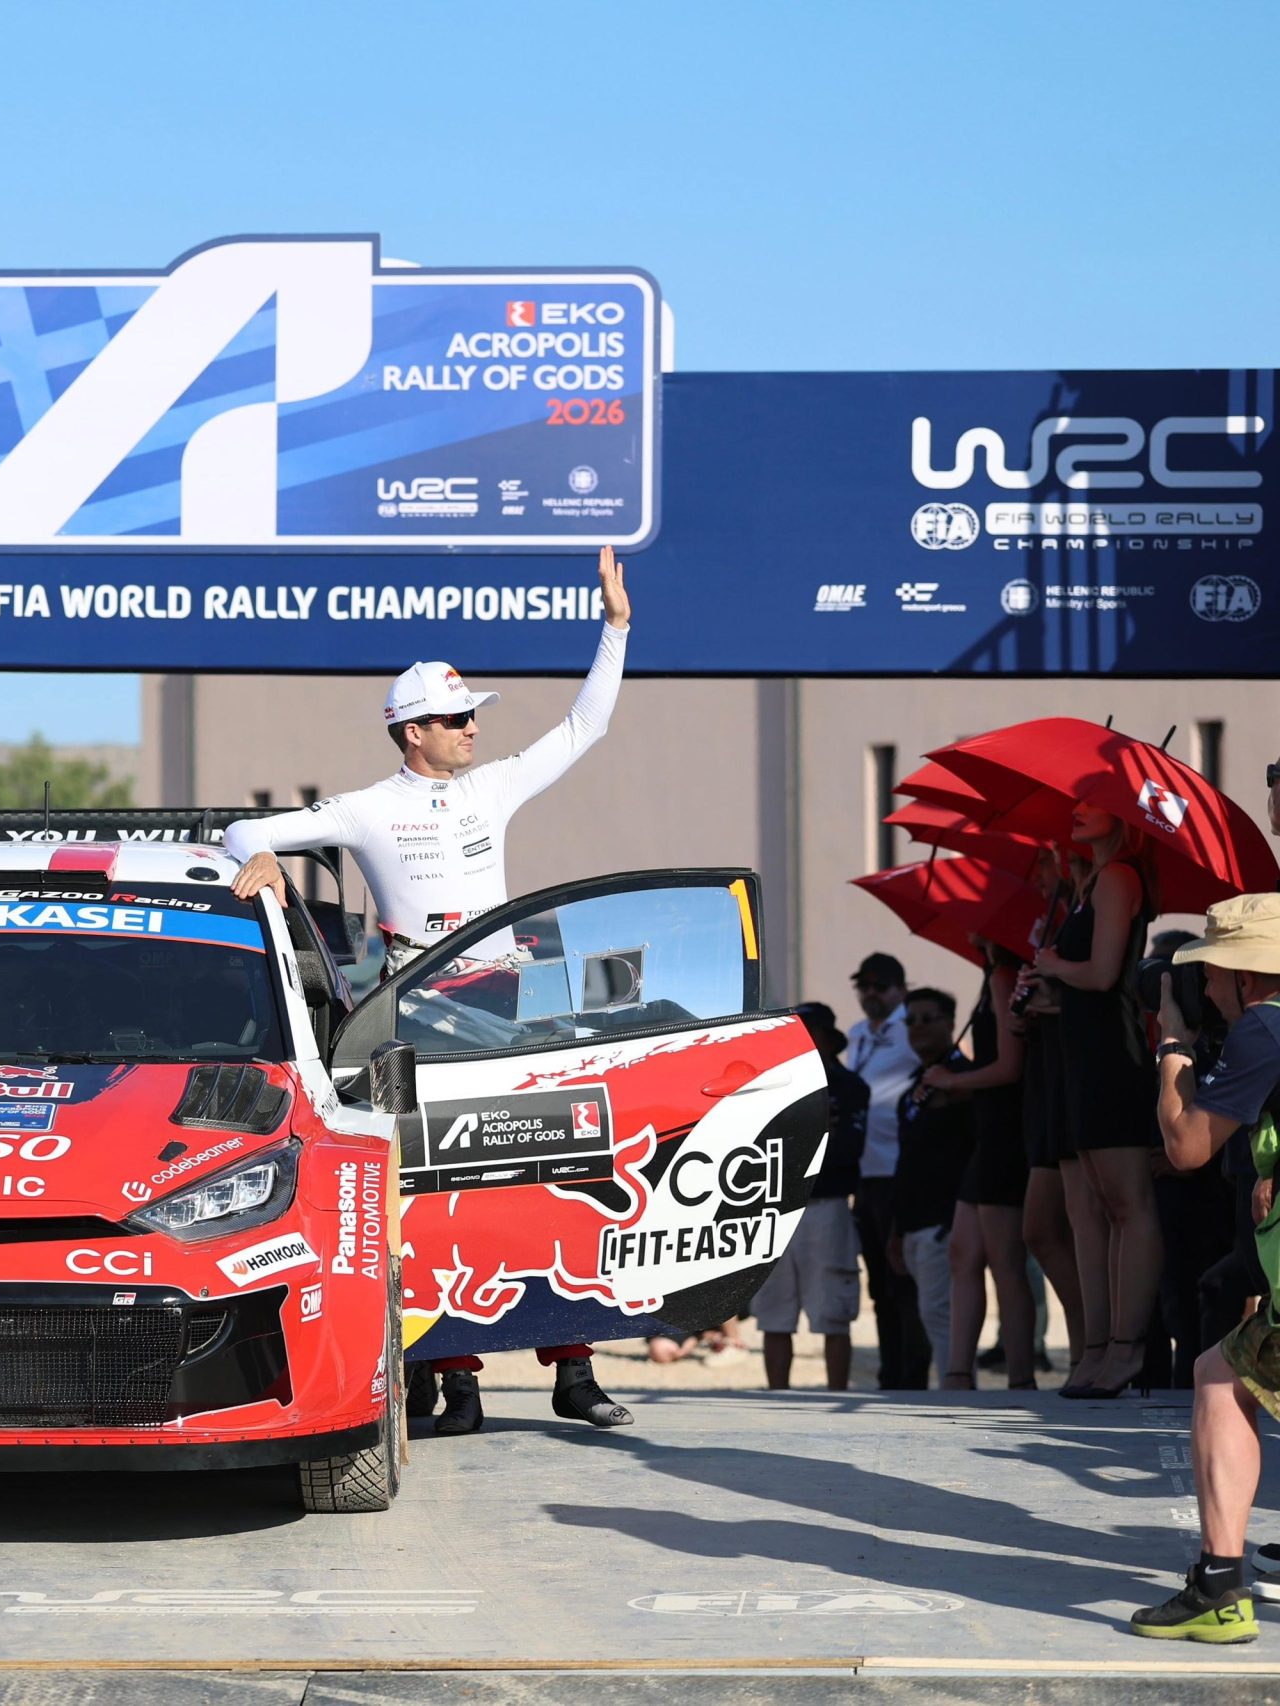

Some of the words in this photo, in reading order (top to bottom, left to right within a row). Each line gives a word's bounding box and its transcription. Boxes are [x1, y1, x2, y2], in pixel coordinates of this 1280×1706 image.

[541, 302, 625, 325] EKO
[445, 332, 625, 358] ACROPOLIS
[383, 365, 477, 390] RALLY
[483, 365, 527, 390] OF
[533, 365, 624, 390] GODS
[546, 398, 625, 425] 2026
[911, 416, 1265, 489] WRC
[377, 477, 478, 500] WRC
[995, 513, 1036, 524] FIA
[1045, 513, 1146, 525] WORLD
[1156, 513, 1254, 525] RALLY
[993, 539, 1254, 550] CHAMPIONSHIP
[61, 585, 191, 620] WORLD
[204, 585, 318, 620] RALLY
[390, 823, 439, 832] DENSO
[1145, 812, 1176, 833] EKO
[6, 829, 97, 843] YOU
[410, 873, 444, 881] PRADA
[110, 893, 212, 912] Racing
[729, 879, 758, 960] 1
[481, 1110, 511, 1121] EKO
[482, 1118, 543, 1134] ACROPOLIS
[483, 1133, 514, 1147] RALLY
[517, 1131, 533, 1143] OF
[534, 1129, 566, 1141] GODS
[450, 1174, 481, 1182] BEYOND
[331, 1161, 358, 1275] Panasonic
[361, 1161, 381, 1280] AUTOMOTIVE
